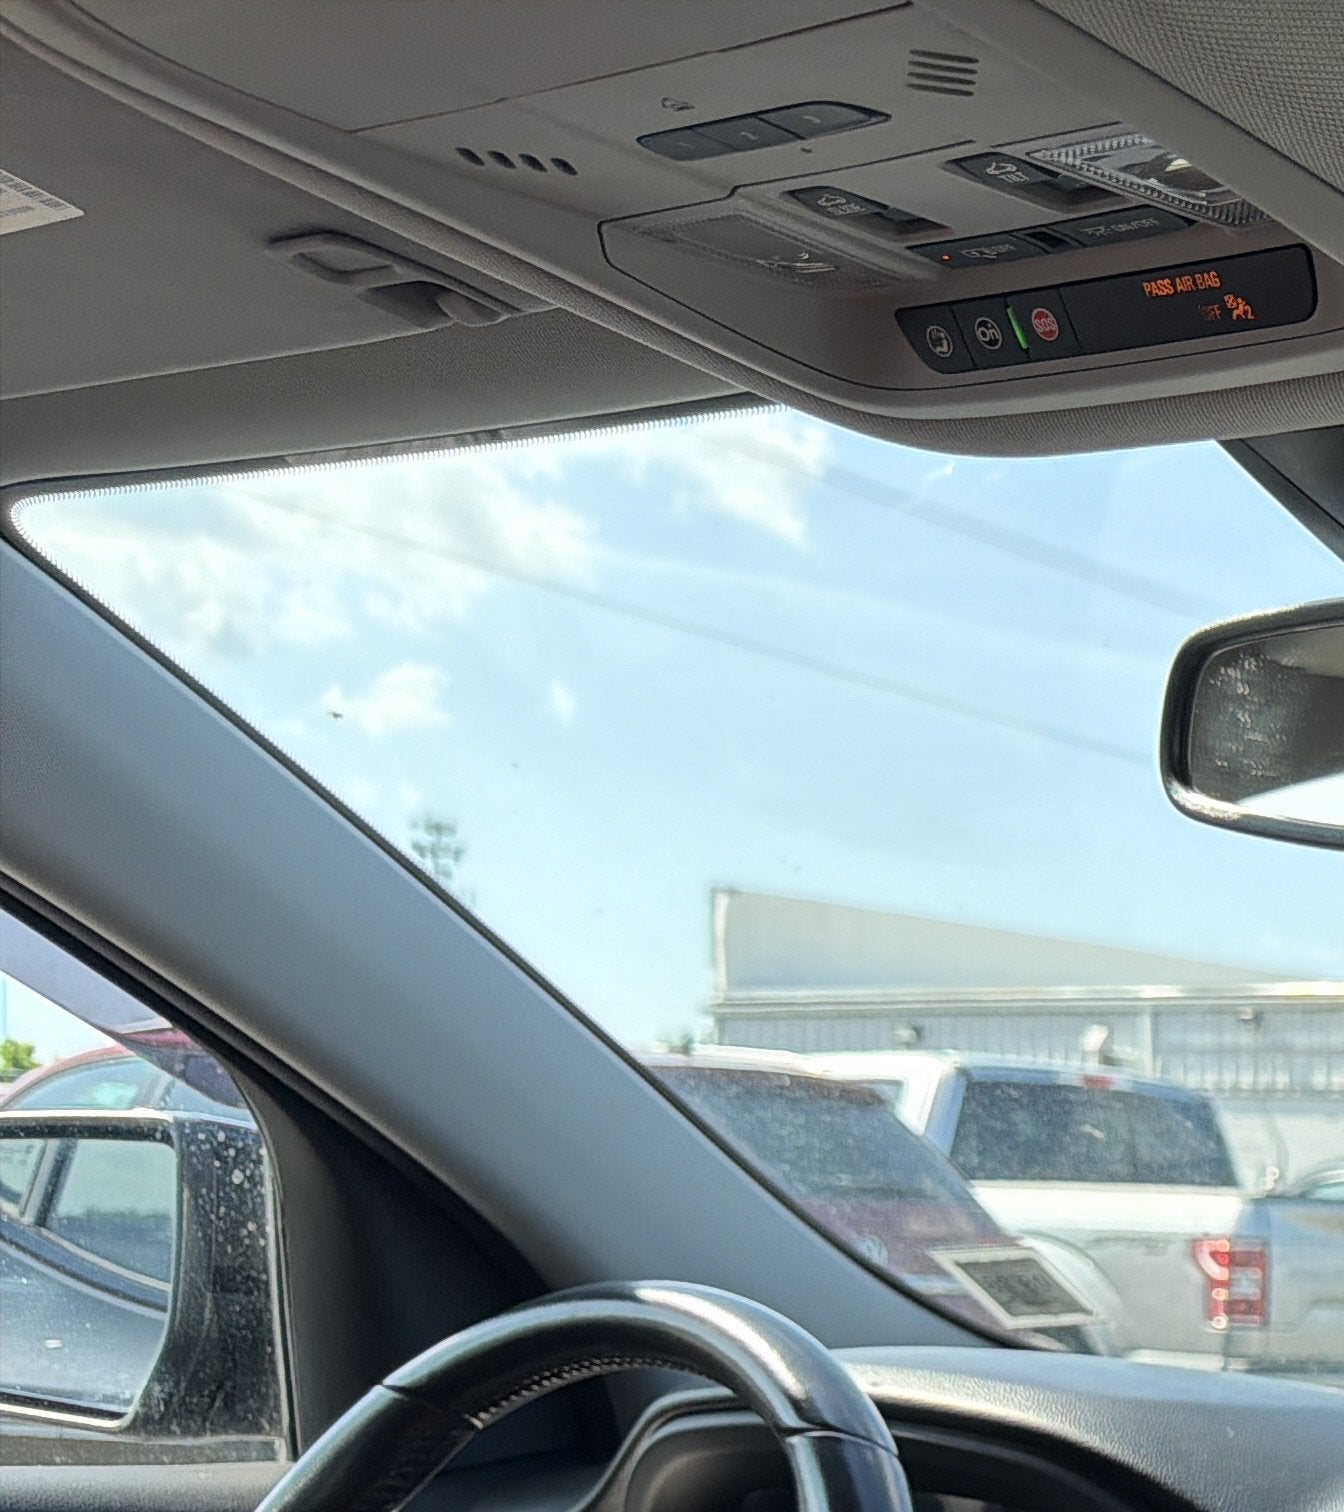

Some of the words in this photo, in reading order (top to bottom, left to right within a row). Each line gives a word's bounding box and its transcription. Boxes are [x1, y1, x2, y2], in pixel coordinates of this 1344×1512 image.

[1142, 278, 1175, 298] PASS
[1175, 275, 1195, 294] AIR
[1196, 271, 1222, 290] BAG
[1033, 316, 1058, 334] SOS
